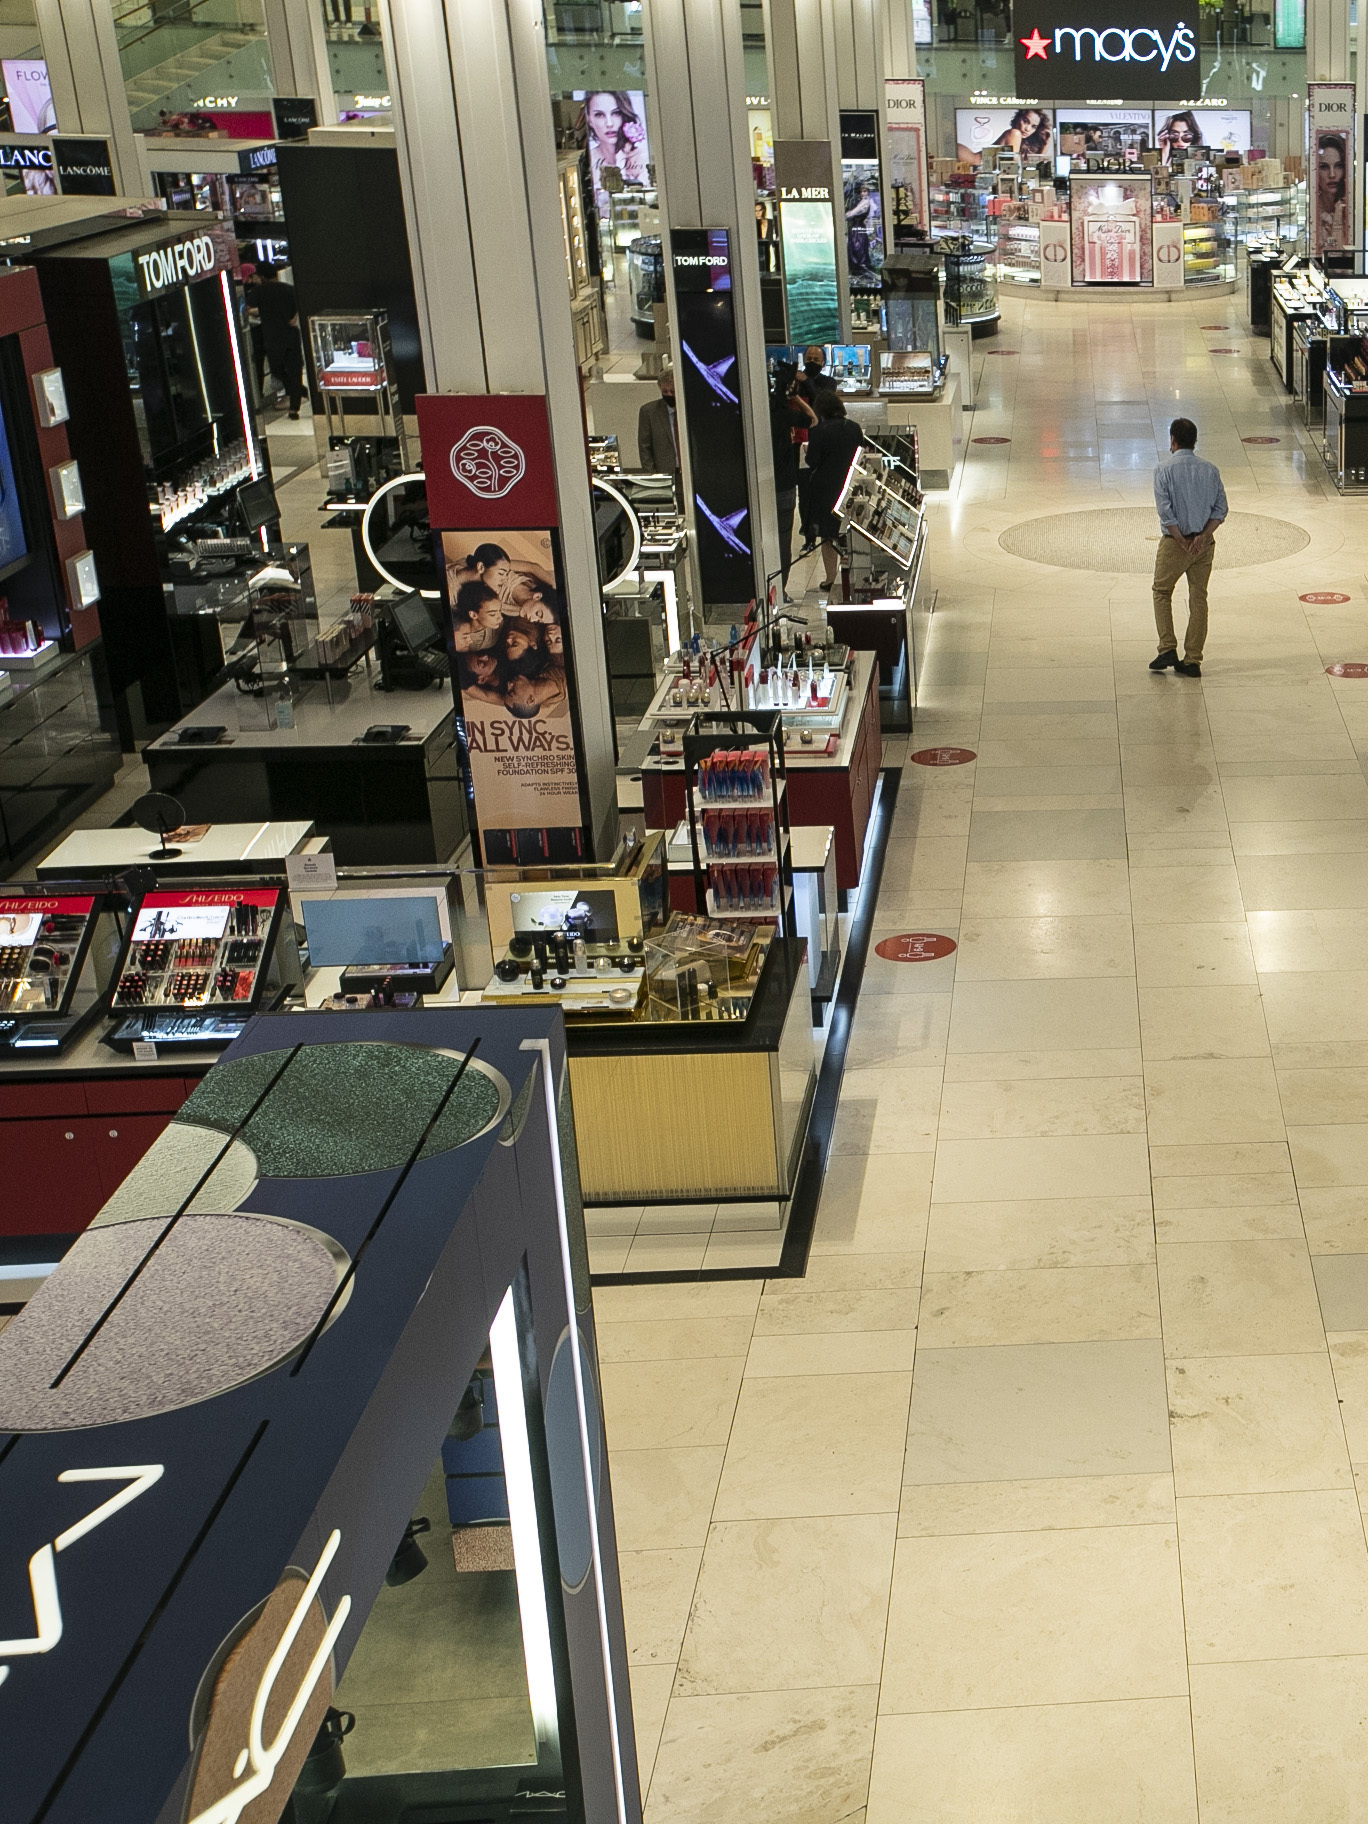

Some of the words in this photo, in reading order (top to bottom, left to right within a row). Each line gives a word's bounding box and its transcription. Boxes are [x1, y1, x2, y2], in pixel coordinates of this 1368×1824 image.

[887, 99, 917, 109] DIOR
[1318, 102, 1347, 113] DIOR
[60, 165, 112, 177] LANCÔME
[1085, 157, 1135, 174] DIOR
[780, 187, 800, 199] LA
[801, 187, 830, 199] MER
[138, 246, 177, 292] TOM
[175, 235, 215, 281] FORD
[675, 255, 699, 266] TOM
[699, 255, 728, 266] FORD
[466, 720, 486, 738] IN
[490, 719, 553, 738] SYNC.
[467, 736, 508, 754] ALL
[508, 735, 574, 753] WAYS.
[494, 755, 515, 763] NEW
[515, 754, 556, 762] SYNCHRO
[502, 761, 576, 769] SELF-REFRESHING
[497, 768, 550, 776] FOUNDATION
[566, 767, 577, 775] 30
[179, 893, 245, 904] SHISEIDO
